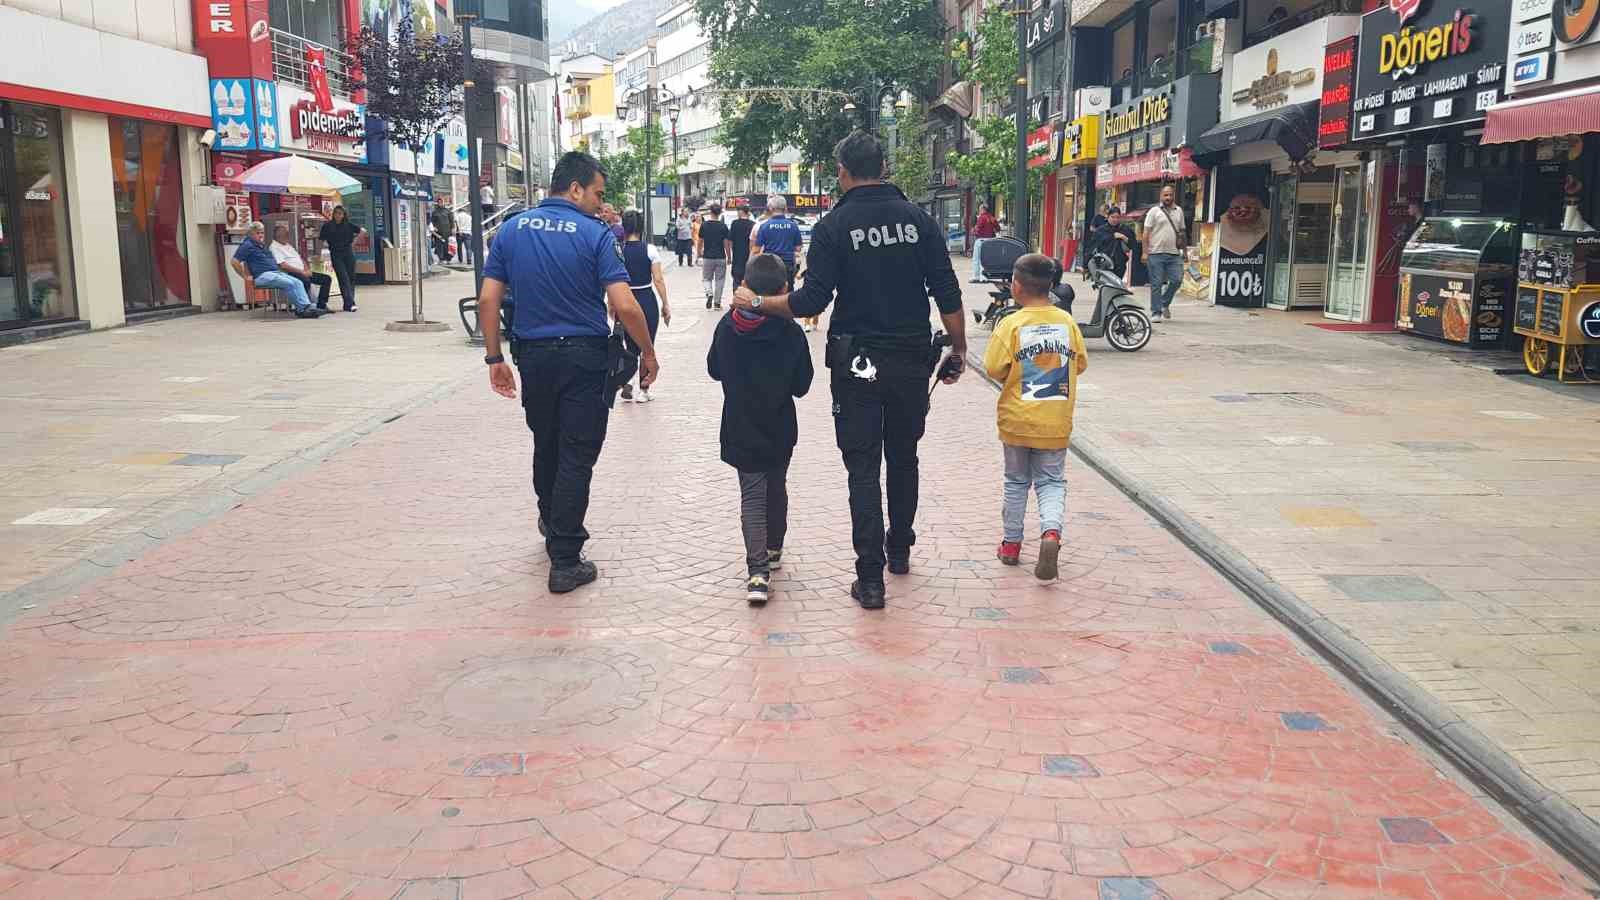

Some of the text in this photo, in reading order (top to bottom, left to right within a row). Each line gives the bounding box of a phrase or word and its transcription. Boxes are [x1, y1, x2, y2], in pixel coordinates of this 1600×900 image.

[1476, 63, 1502, 85] SİMİT
[1392, 86, 1416, 103] DÖNER
[1142, 92, 1169, 127] Pide
